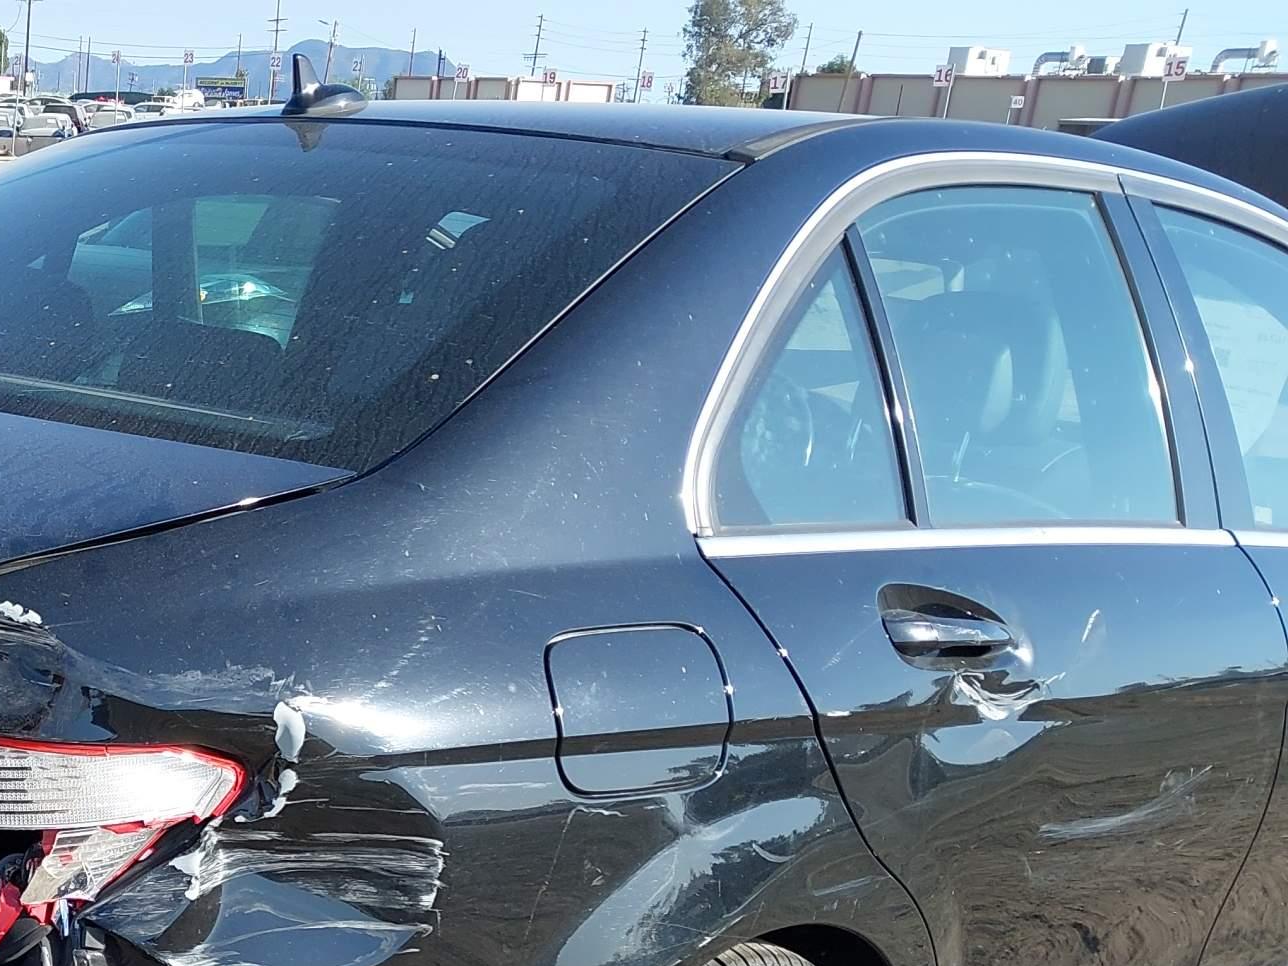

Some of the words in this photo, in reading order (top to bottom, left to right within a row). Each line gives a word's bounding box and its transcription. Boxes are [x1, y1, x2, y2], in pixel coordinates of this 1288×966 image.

[183, 52, 194, 63] 23
[271, 57, 280, 67] 22
[456, 67, 468, 79] 20
[1164, 60, 1187, 76] 15
[544, 72, 556, 84] 19
[934, 68, 952, 82] 16
[641, 75, 653, 88] 18
[770, 76, 787, 89] 17
